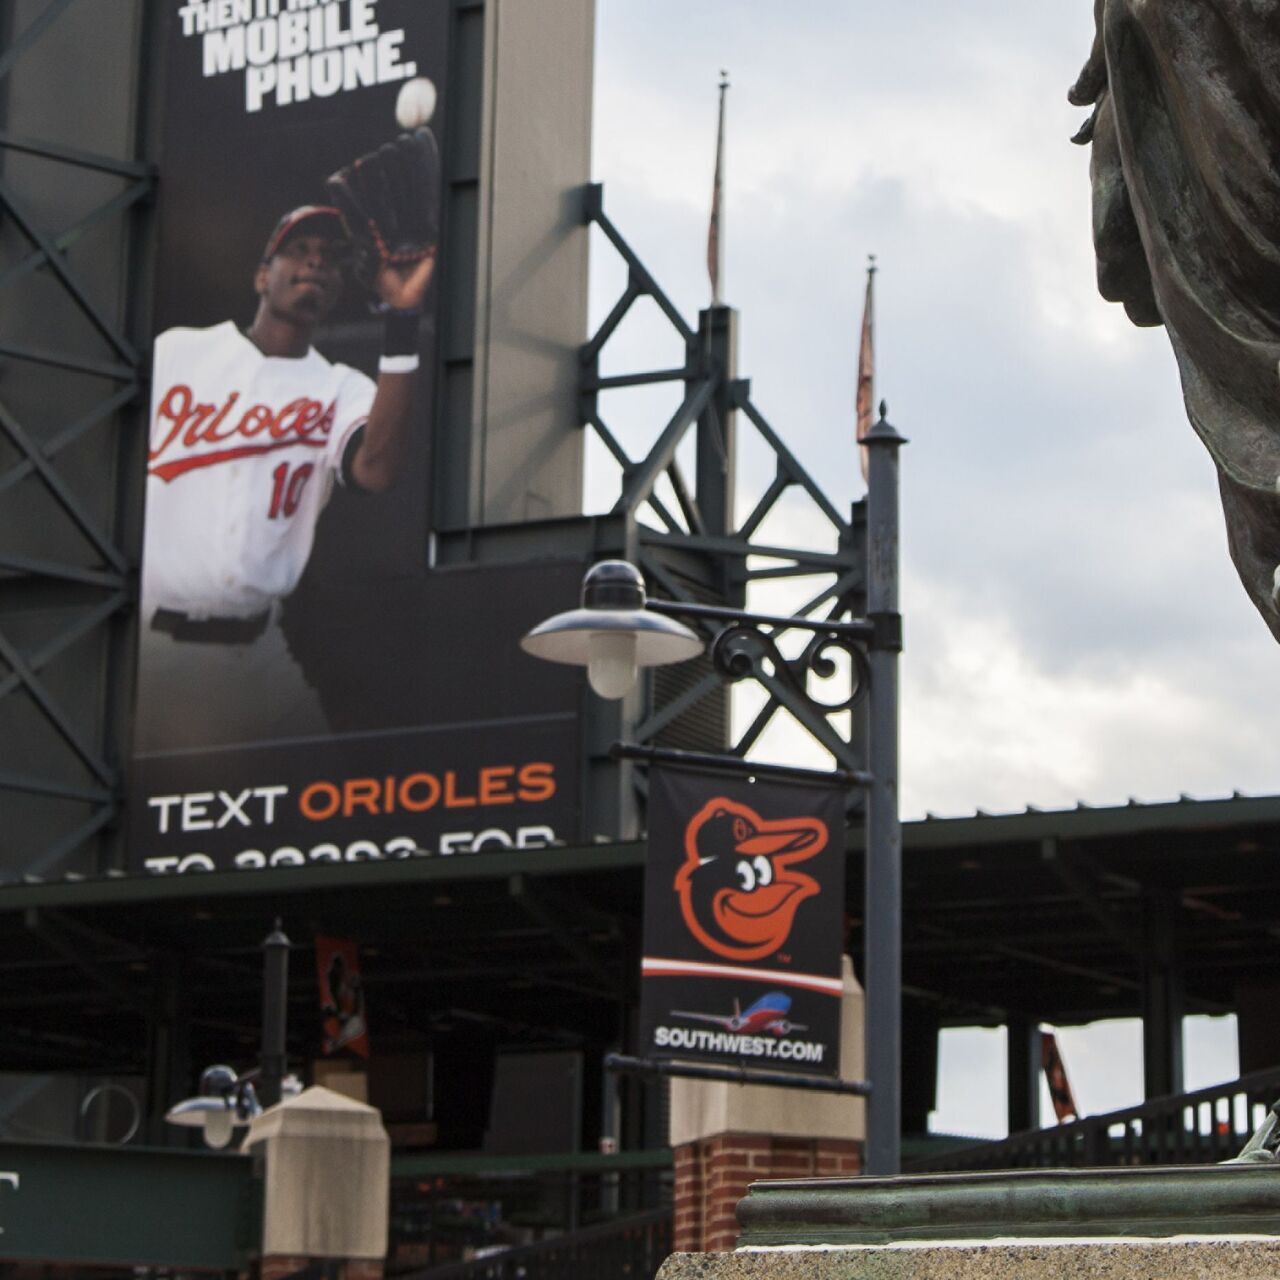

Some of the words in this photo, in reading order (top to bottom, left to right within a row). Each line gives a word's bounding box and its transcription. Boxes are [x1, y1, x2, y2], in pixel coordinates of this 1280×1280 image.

[245, 29, 417, 113] PHONE.
[267, 461, 314, 520] 10
[147, 786, 289, 834] TEXT
[298, 762, 557, 822] ORIOLES
[654, 1026, 824, 1062] SOUTHWEST.COM
